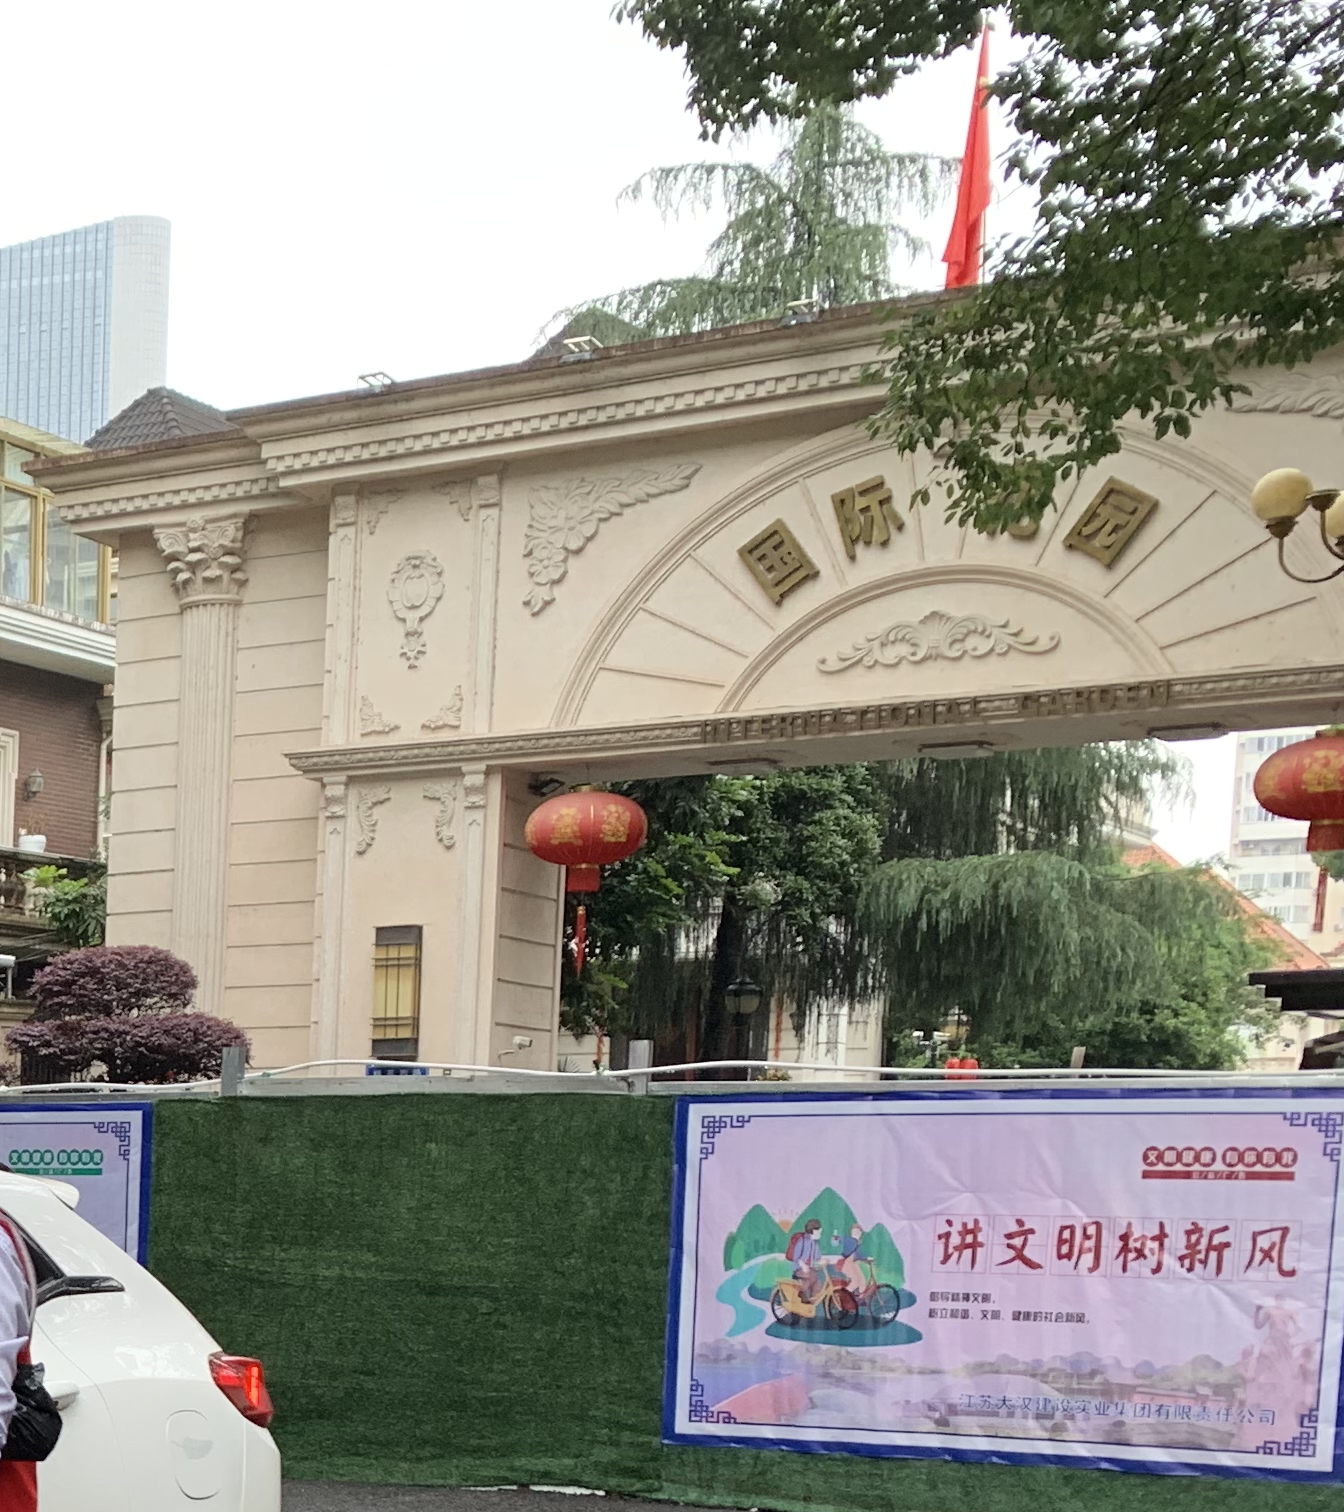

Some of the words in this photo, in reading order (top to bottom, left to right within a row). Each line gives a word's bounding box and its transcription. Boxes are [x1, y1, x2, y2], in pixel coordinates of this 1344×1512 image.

[737, 474, 1160, 606] 国际园
[1021, 680, 1170, 718] GARDEN
[936, 1217, 1297, 1278] 讲文明树新风
